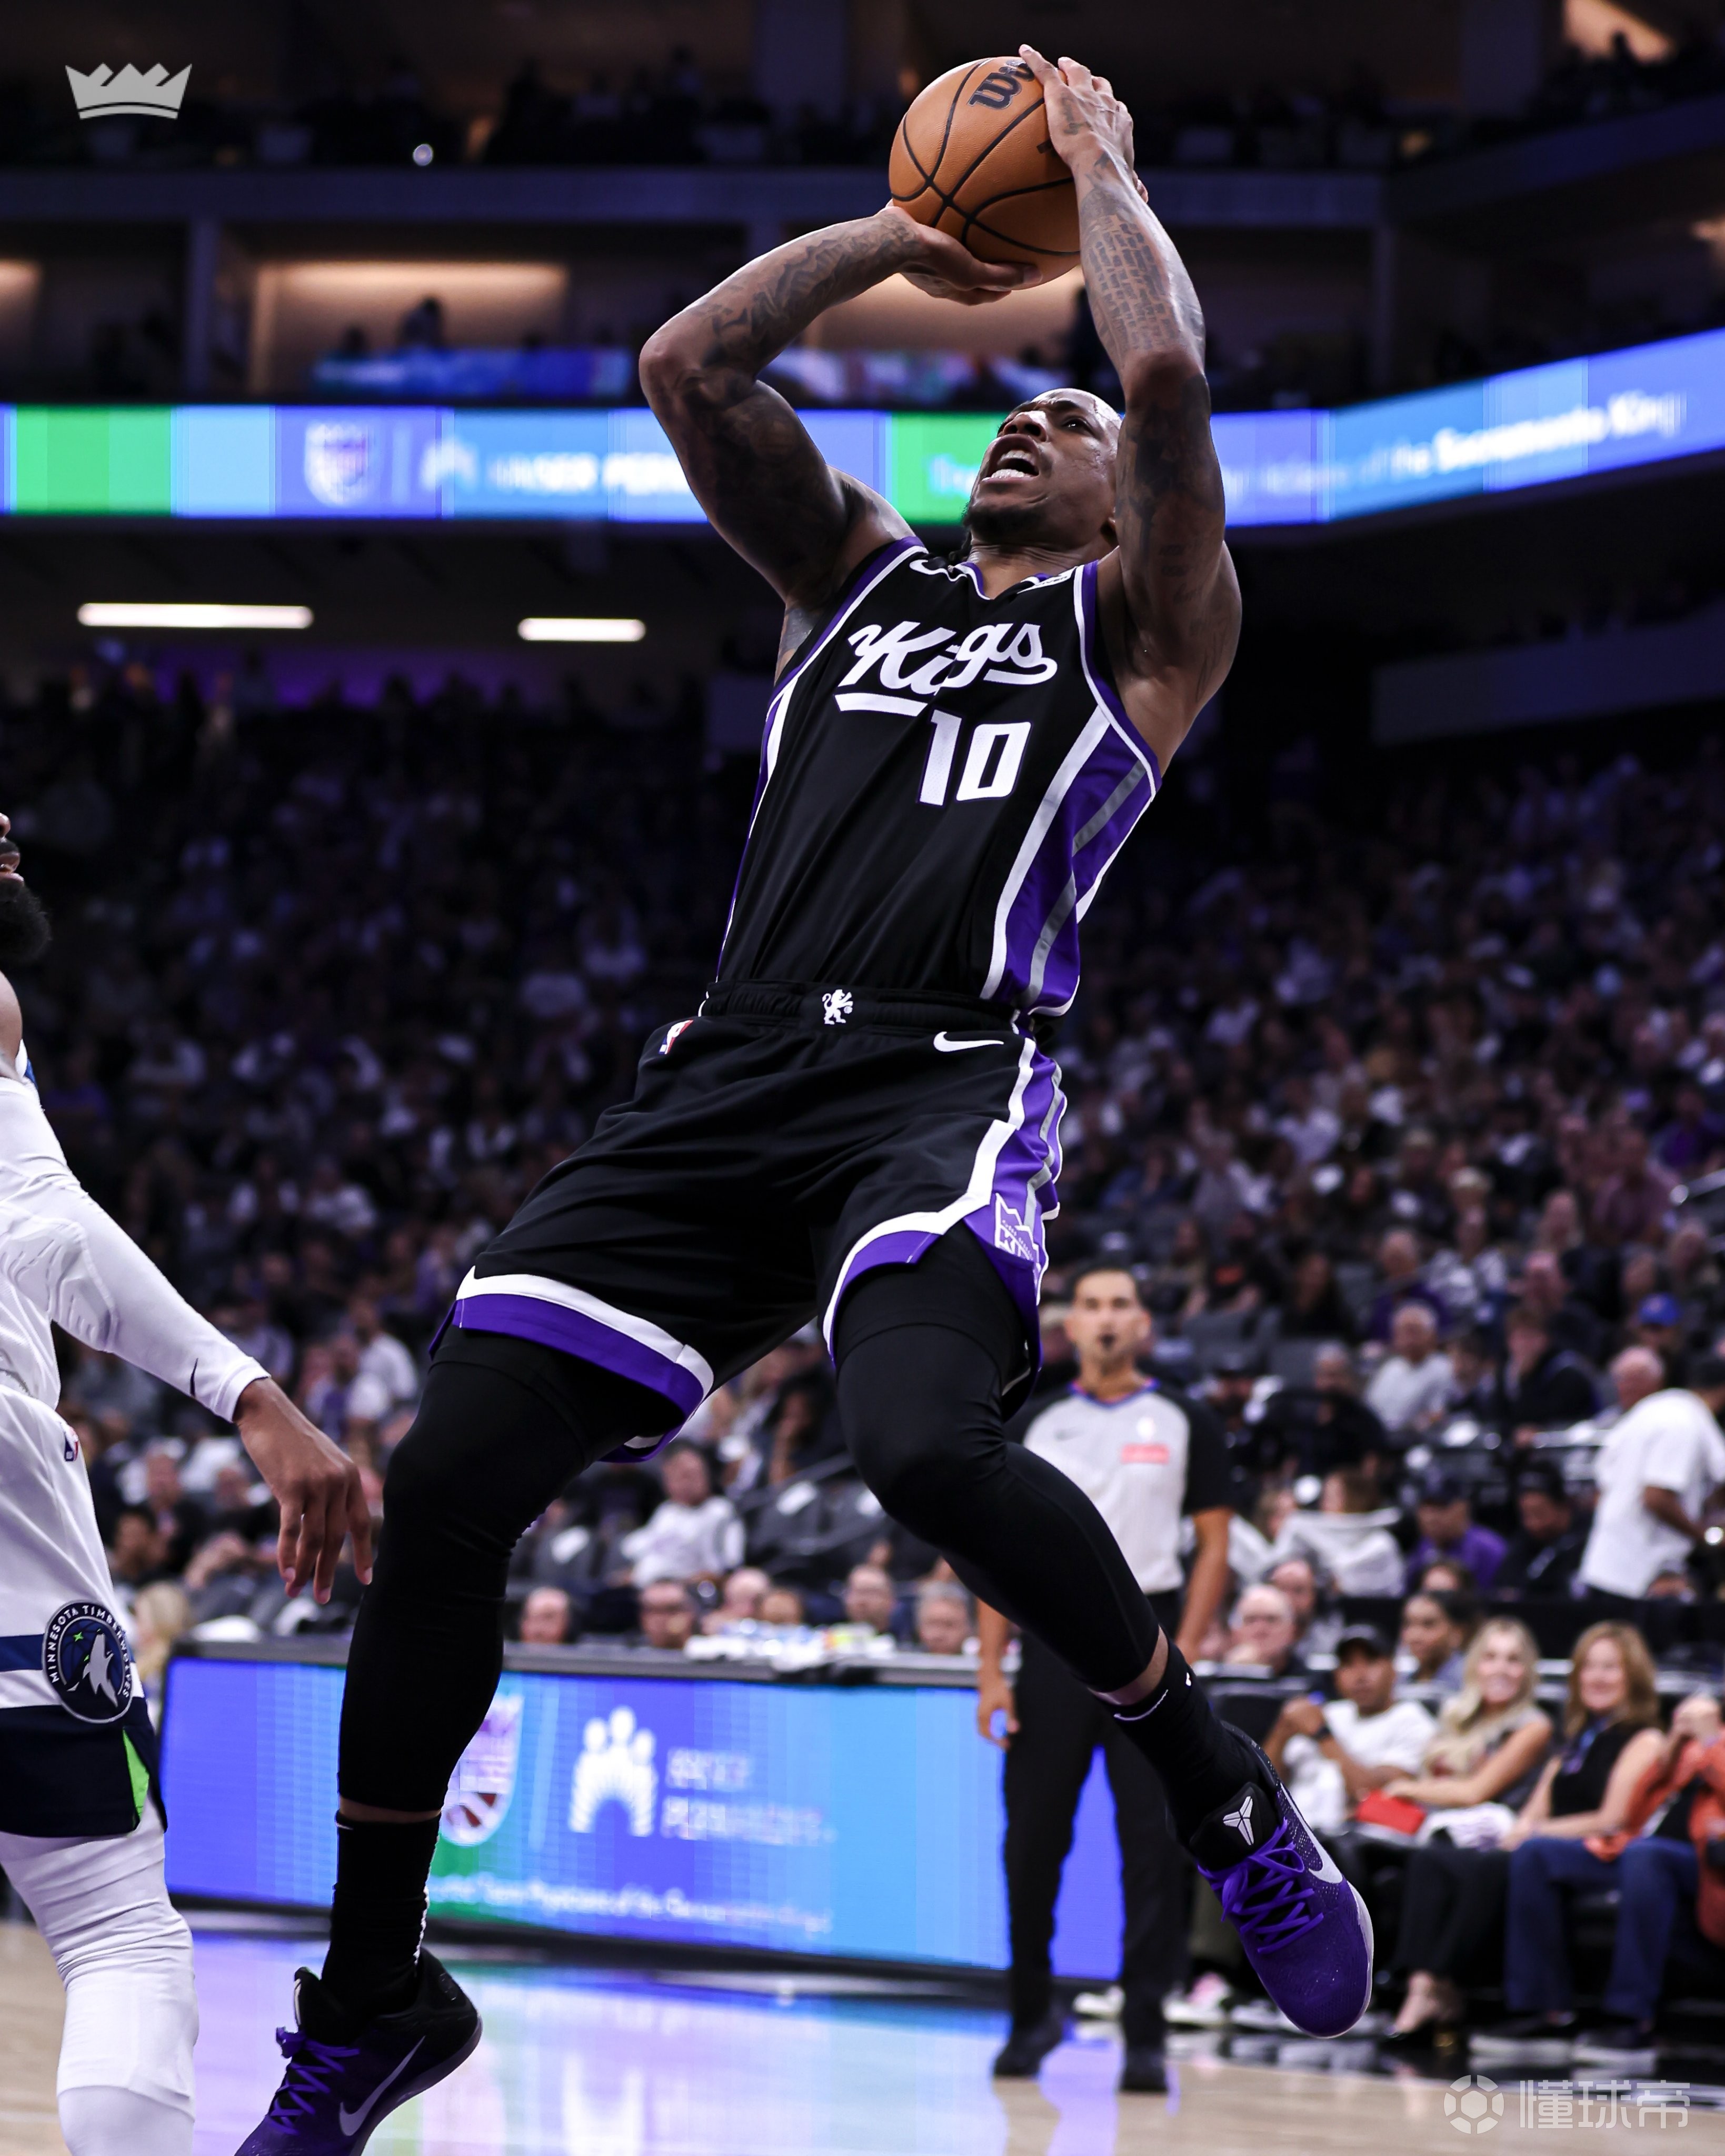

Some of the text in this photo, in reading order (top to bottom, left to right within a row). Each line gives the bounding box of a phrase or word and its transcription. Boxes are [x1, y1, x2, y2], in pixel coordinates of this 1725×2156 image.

[838, 621, 1058, 696] Kigs
[919, 709, 1031, 806] 10
[47, 1607, 78, 1683] MINNESOTA
